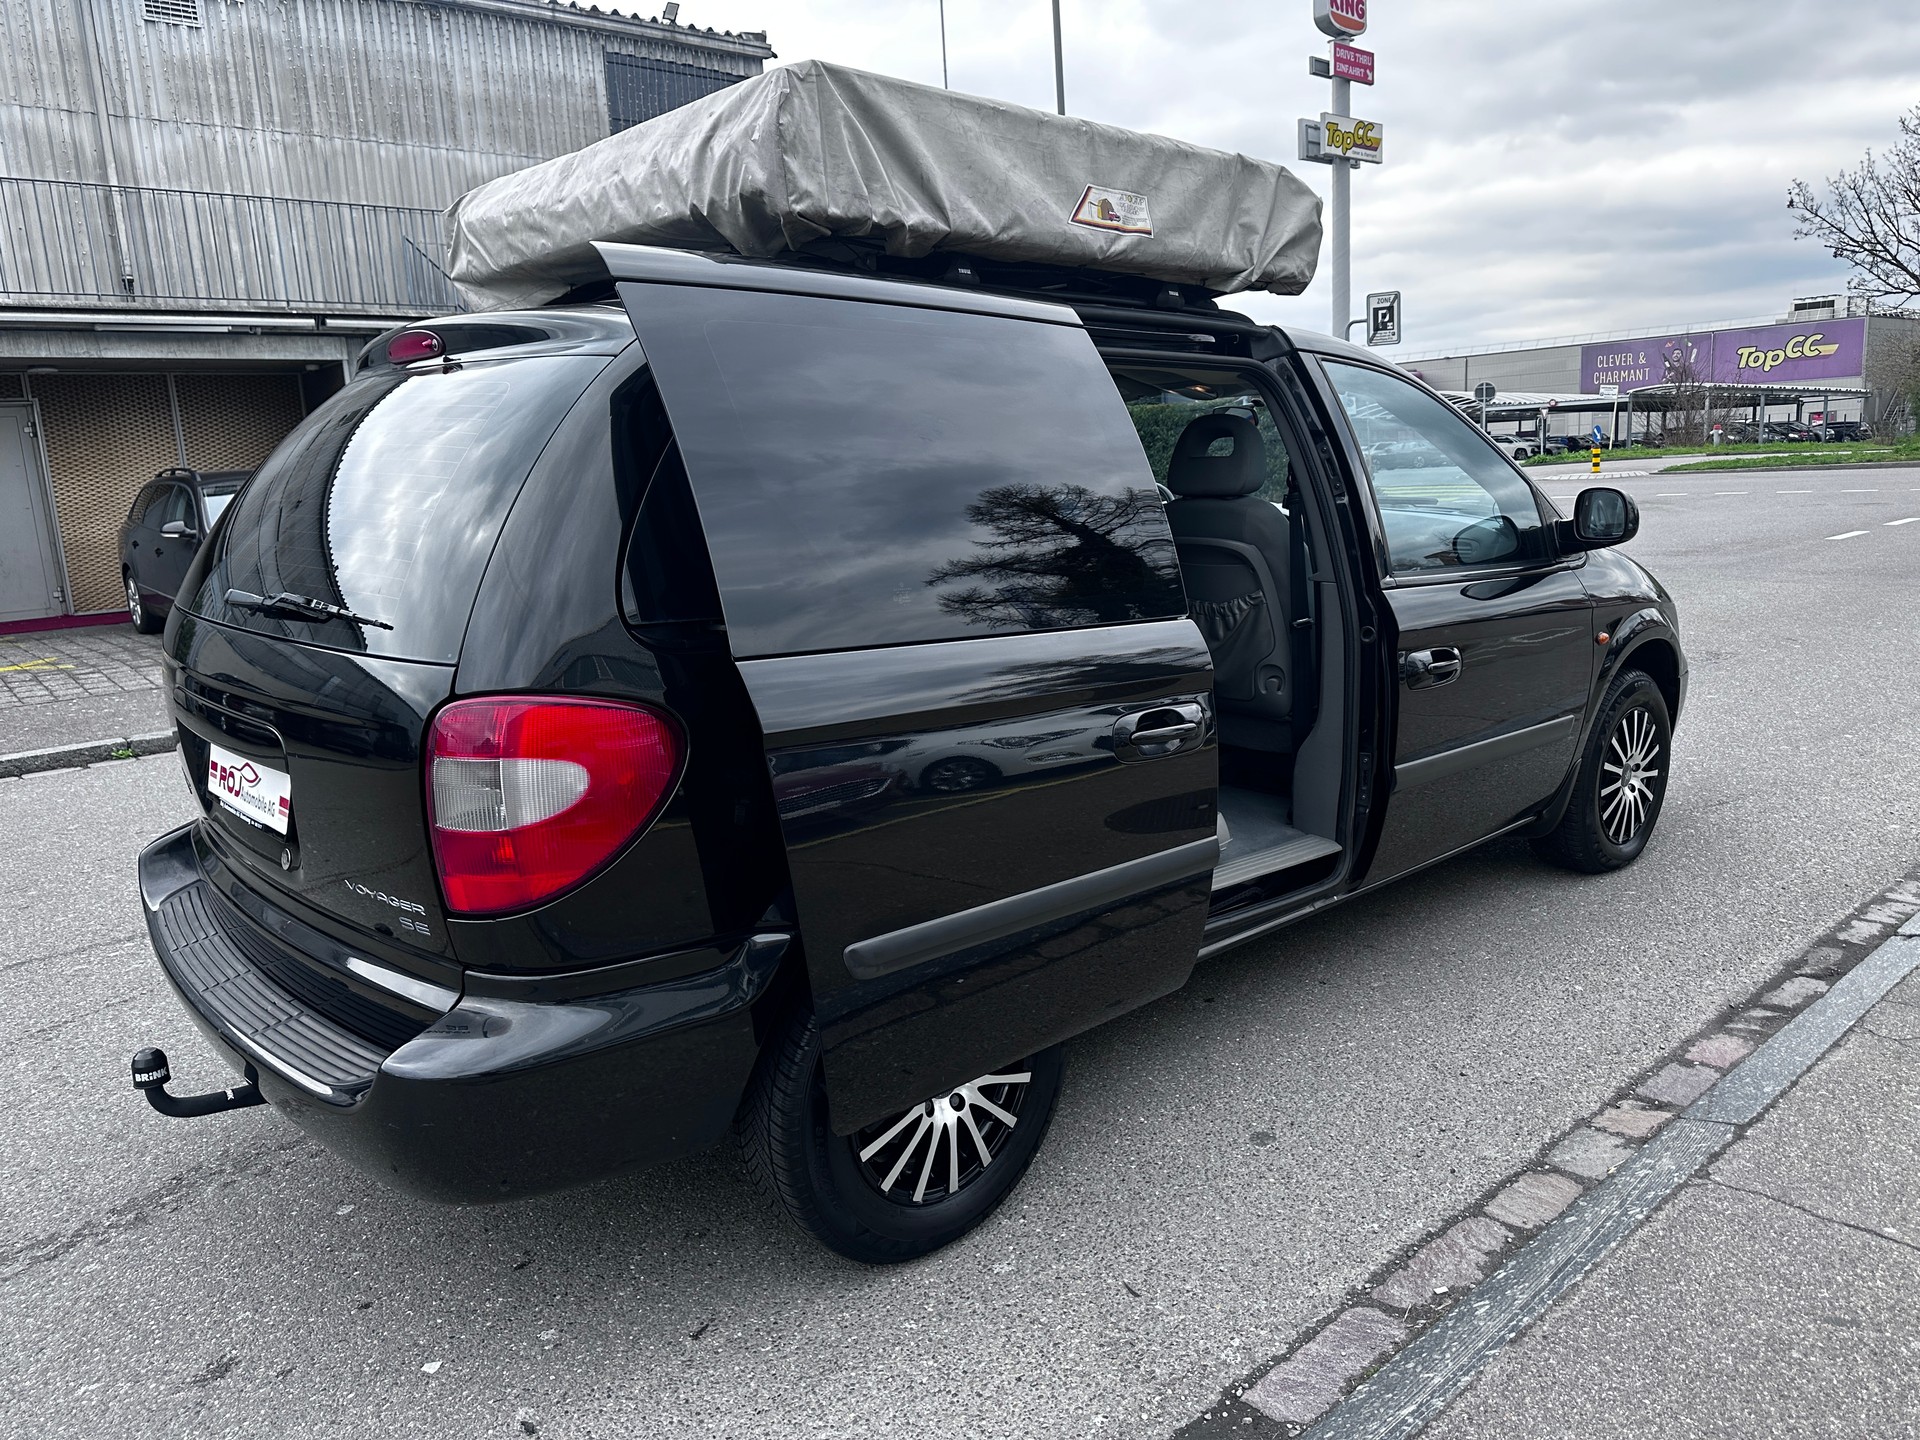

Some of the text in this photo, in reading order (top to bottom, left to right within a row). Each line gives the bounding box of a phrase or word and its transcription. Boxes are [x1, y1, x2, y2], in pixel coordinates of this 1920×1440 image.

[1336, 47, 1372, 66] DRIVE THRU
[1336, 62, 1364, 77] EINFAHRT
[1325, 121, 1374, 155] TopCC
[1377, 297, 1392, 308] ZONE
[1597, 351, 1647, 368] CLEVER &
[1736, 333, 1825, 372] TopCC
[1593, 368, 1650, 384] CHARMANT
[240, 786, 267, 813] Automobile
[267, 800, 276, 817] AG
[344, 879, 426, 915] VOYAGER
[399, 917, 431, 936] SE
